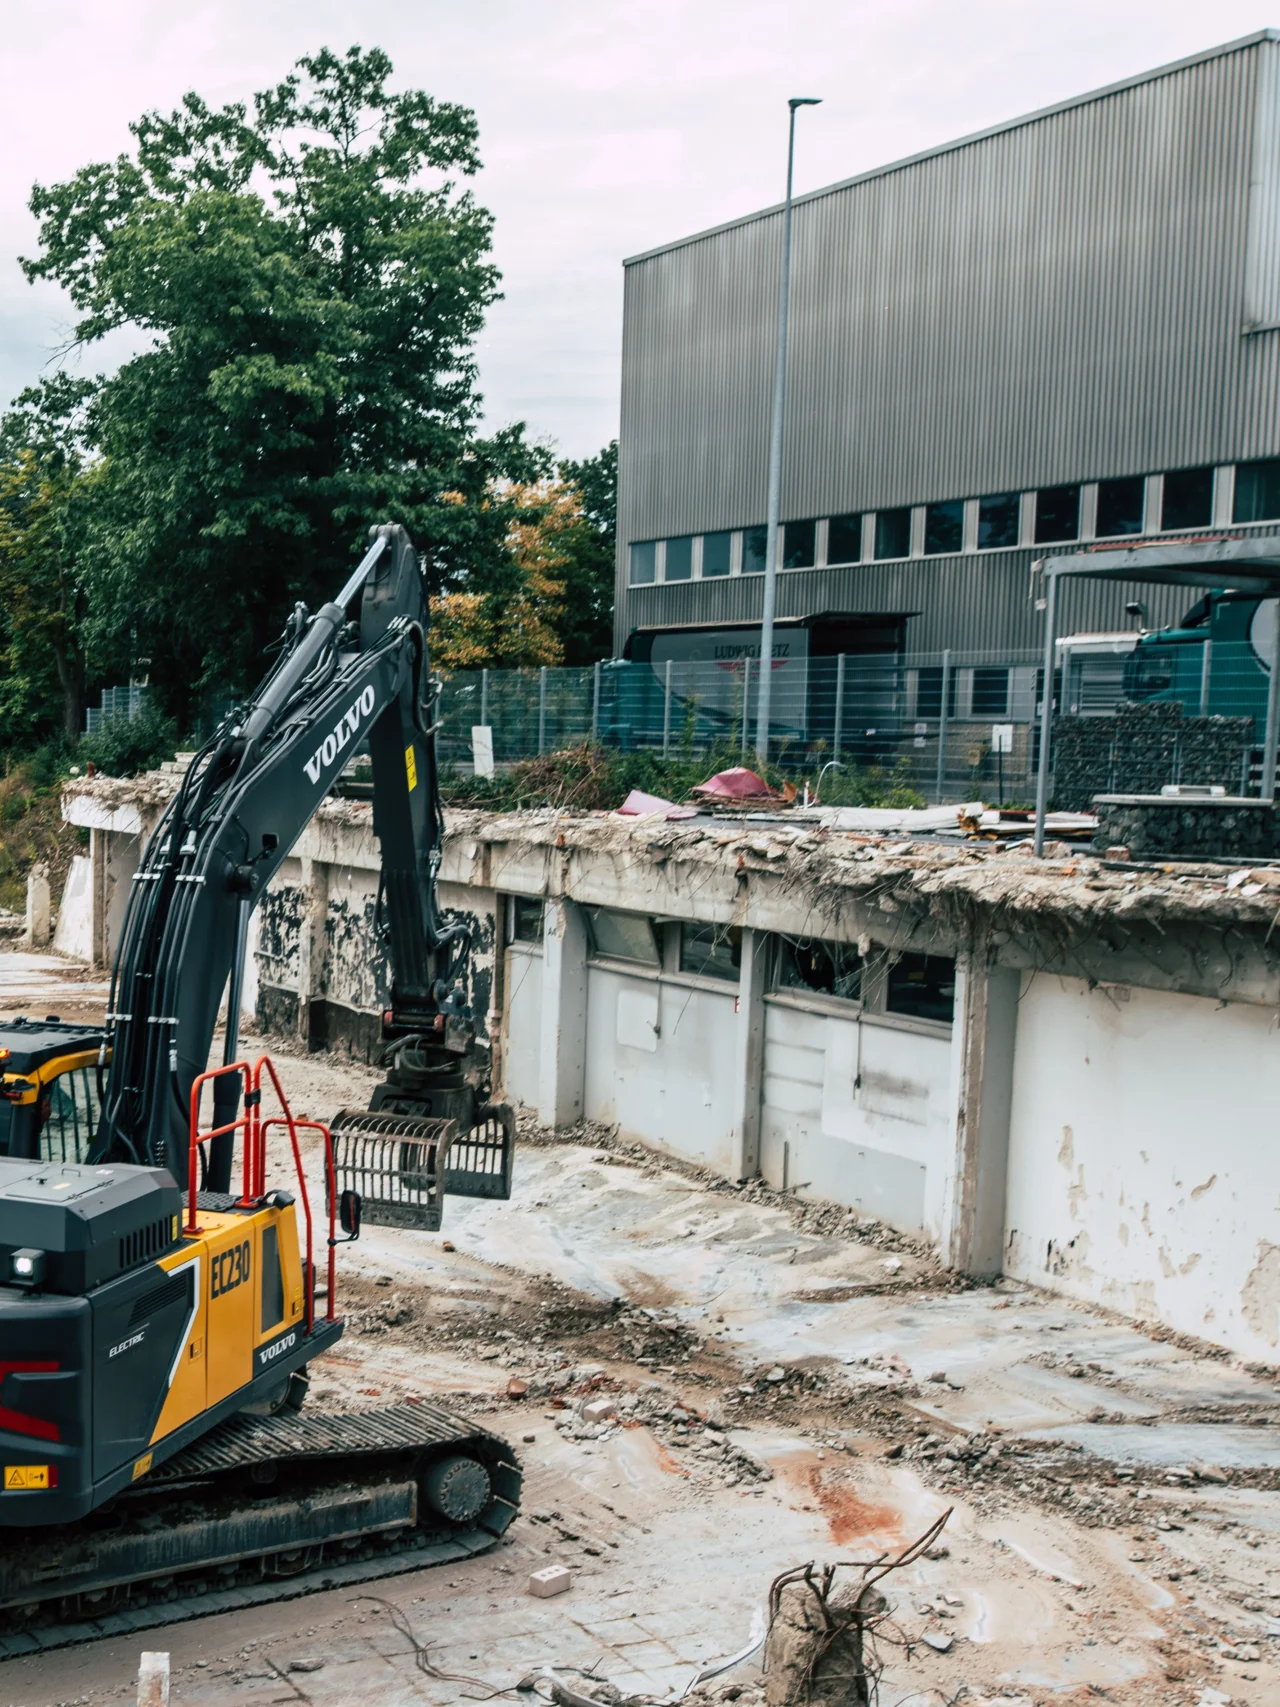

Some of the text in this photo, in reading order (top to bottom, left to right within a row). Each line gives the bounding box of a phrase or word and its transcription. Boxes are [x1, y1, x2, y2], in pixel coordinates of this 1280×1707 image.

[302, 684, 376, 785] VOLVO
[210, 1239, 251, 1301] EC230
[108, 1331, 145, 1358] ELECTRIC
[258, 1332, 296, 1364] VOLVO
